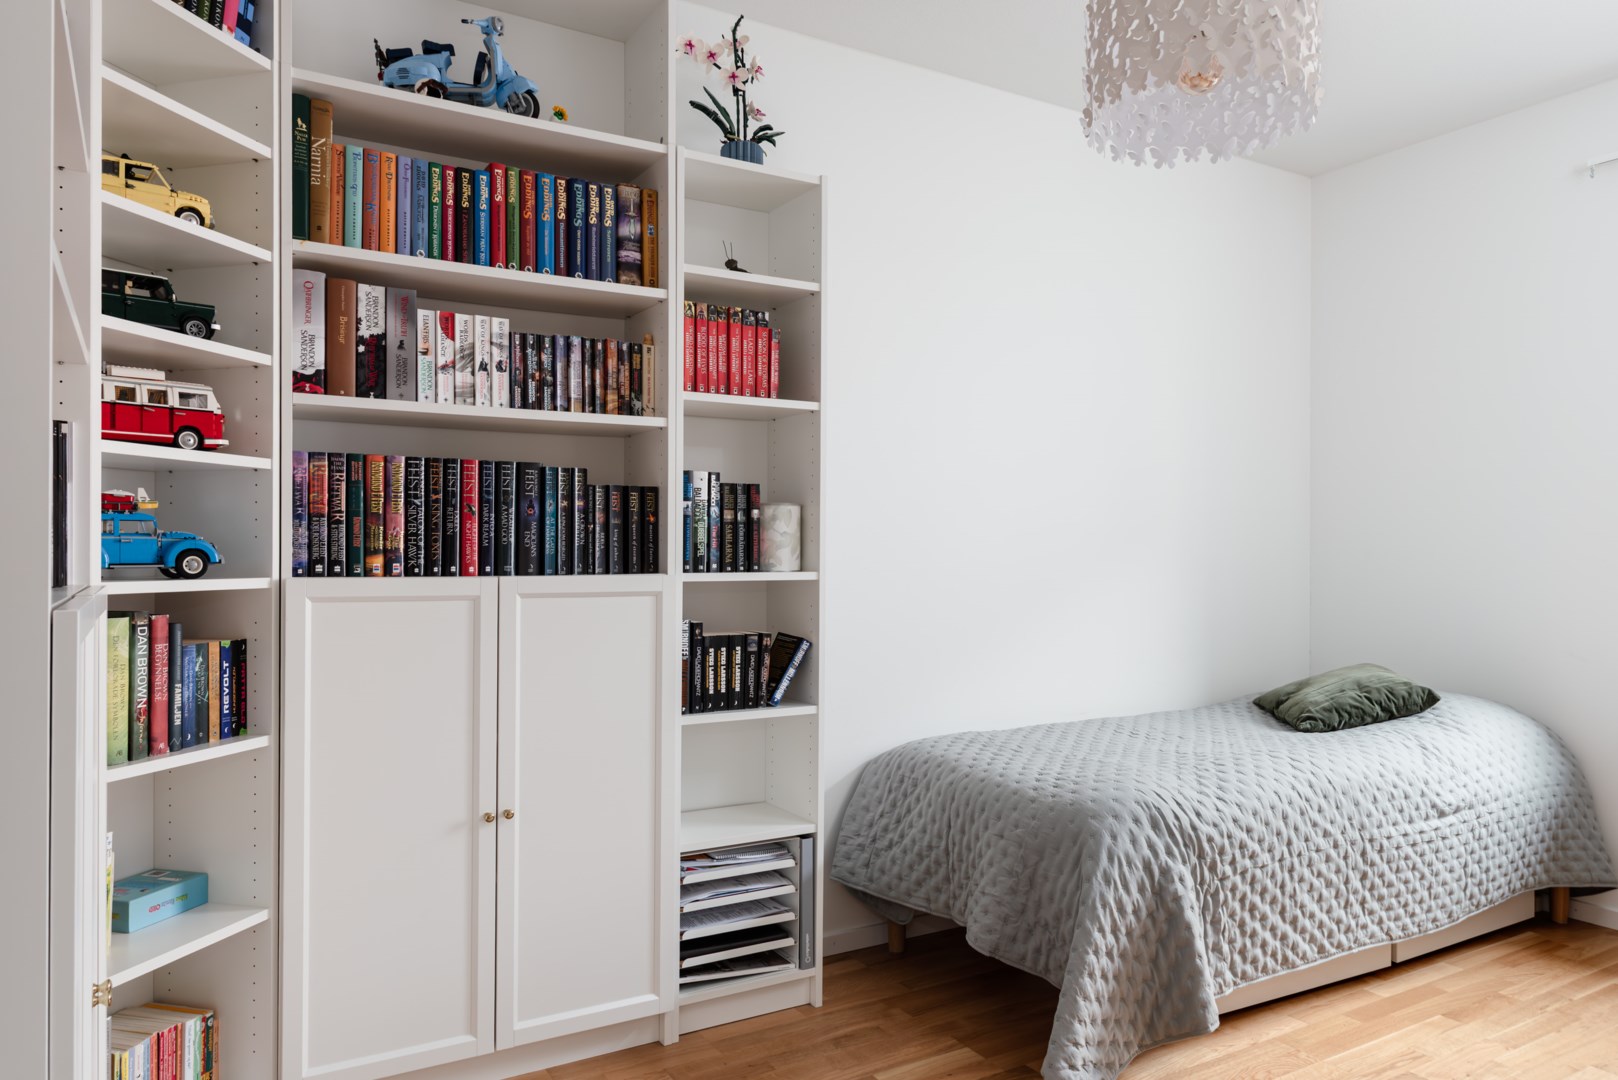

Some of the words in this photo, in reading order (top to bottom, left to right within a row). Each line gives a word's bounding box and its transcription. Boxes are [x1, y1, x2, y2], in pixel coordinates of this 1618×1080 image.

[311, 136, 326, 185] Narnia
[464, 464, 475, 498] FEIST
[525, 469, 534, 498] FEIST
[408, 505, 416, 534] SILVER
[408, 537, 416, 567] HAWK
[138, 627, 147, 654] DAN
[137, 658, 147, 708] BROWN
